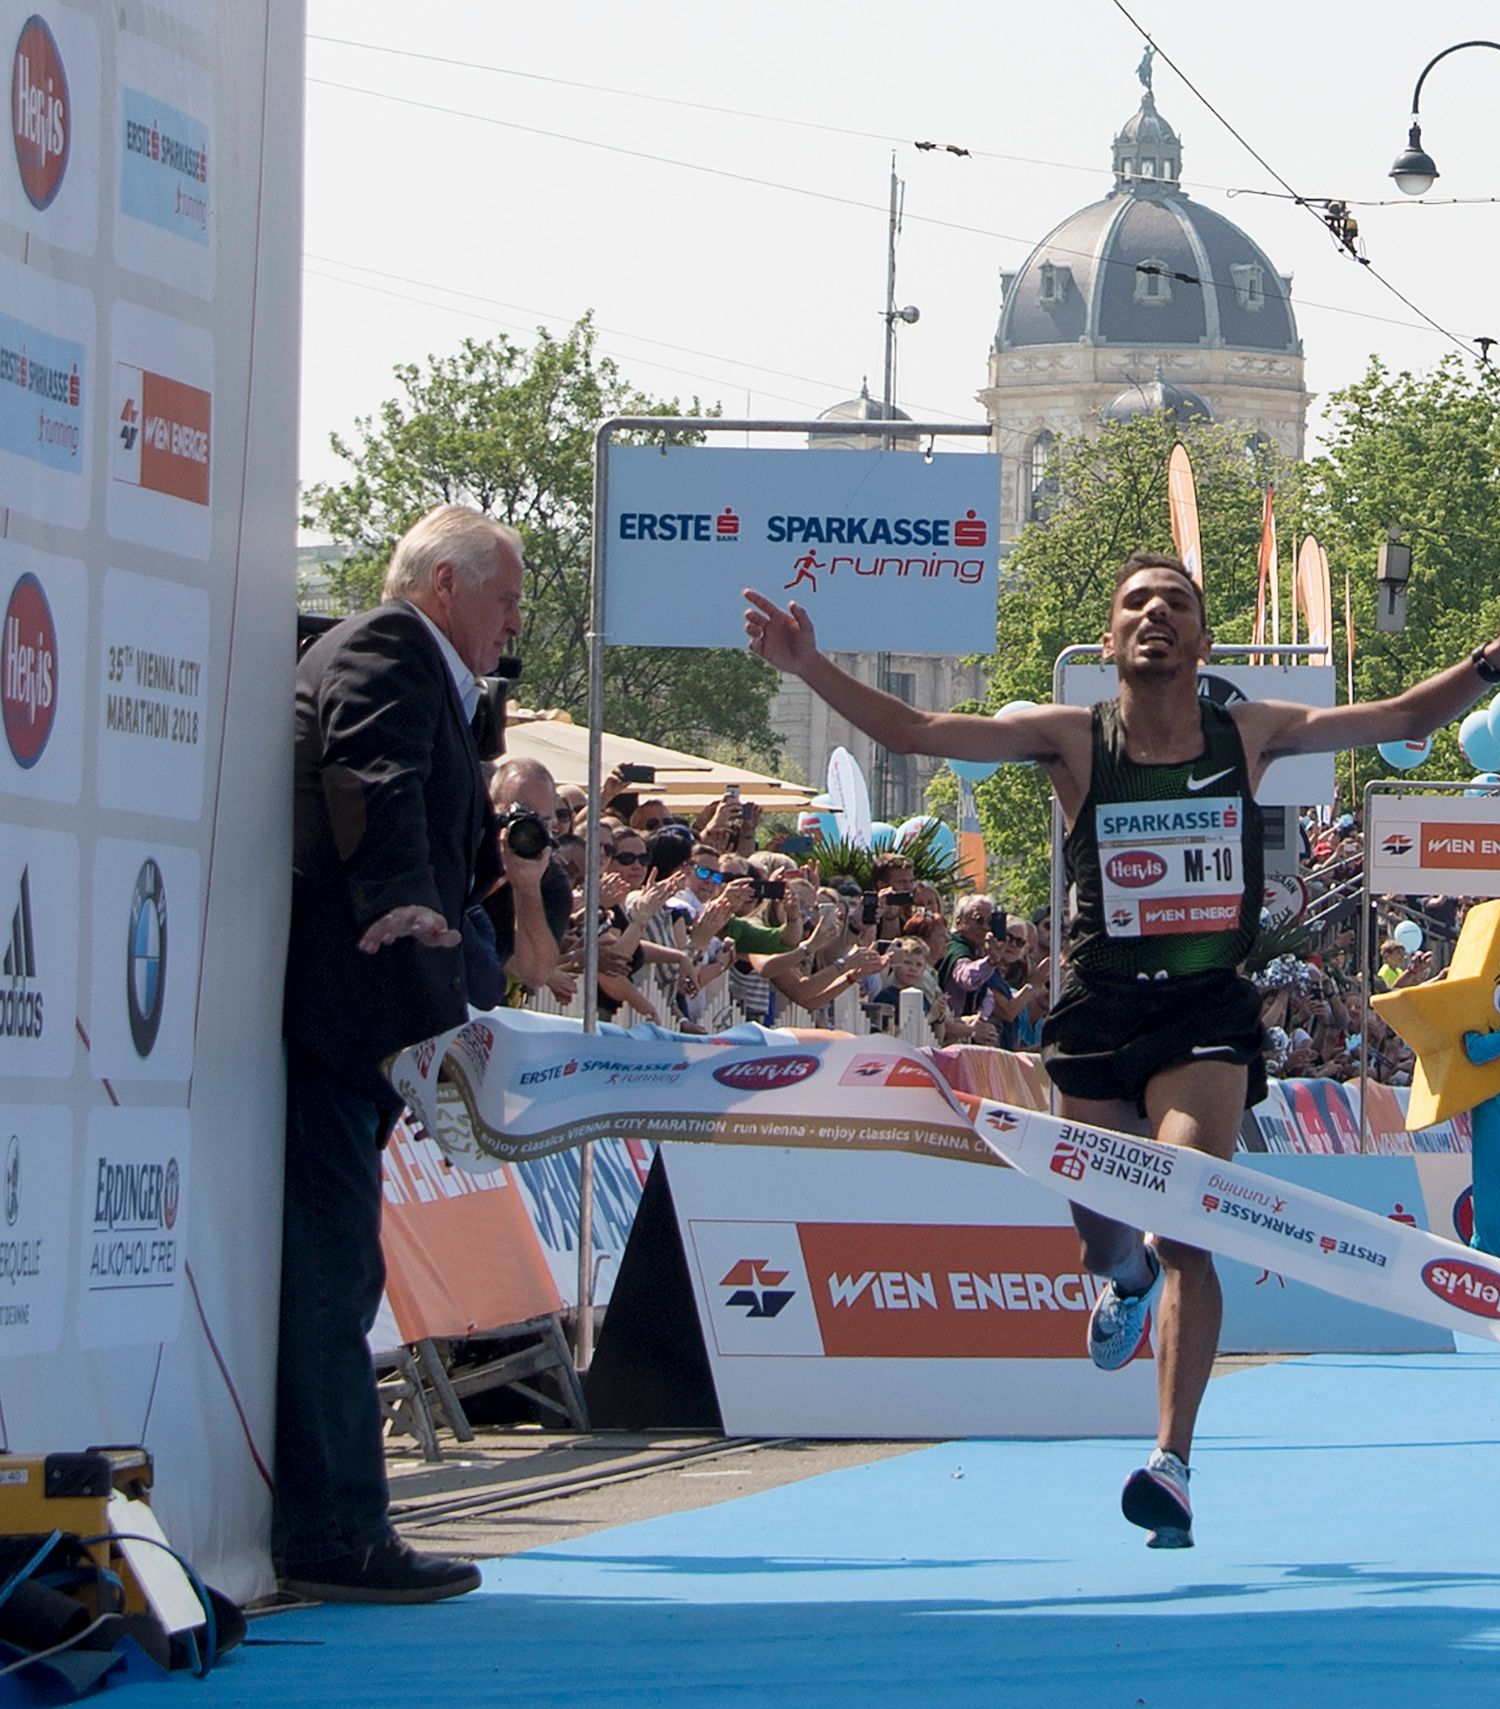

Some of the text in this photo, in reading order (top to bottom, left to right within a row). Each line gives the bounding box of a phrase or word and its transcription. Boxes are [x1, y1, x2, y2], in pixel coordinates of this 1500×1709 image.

[18, 53, 64, 167] Hervis
[127, 119, 201, 182] ERSTE SPARKASSE
[619, 512, 712, 542] ERSTE
[766, 515, 950, 547] SPARKASSE
[829, 551, 985, 585] running
[7, 616, 52, 724] Hervis
[136, 650, 175, 694] VIENNA
[178, 658, 201, 698] CITY
[106, 694, 199, 745] MARATHON 2018
[1103, 810, 1221, 835] SPARKASSE
[1428, 837, 1475, 854] WIEN
[1111, 847, 1233, 883] Hervis M-10
[1145, 908, 1185, 923] WIEN
[520, 1060, 671, 1085] ERSTE SPARKASSE
[620, 1071, 680, 1084] running
[722, 1055, 809, 1082] Hervis
[567, 1119, 610, 1140] VIENNA
[614, 1117, 644, 1130] CITY
[647, 1119, 726, 1134] MARATHON
[732, 1124, 757, 1135] run
[761, 1121, 806, 1136] vienna
[818, 1126, 856, 1142] enjoy
[859, 1125, 910, 1142] classics
[914, 1130, 969, 1150] VIENNA
[1059, 1124, 1175, 1176] STÄDTISCHE
[1090, 1155, 1167, 1193] WIENER
[1207, 1174, 1271, 1206] running
[95, 1157, 164, 1230] ERDINGER
[1220, 1200, 1388, 1268] ERSTE SPARKASSE
[90, 1239, 177, 1277] ALKOHOLFREI
[827, 1271, 937, 1310] WIEN
